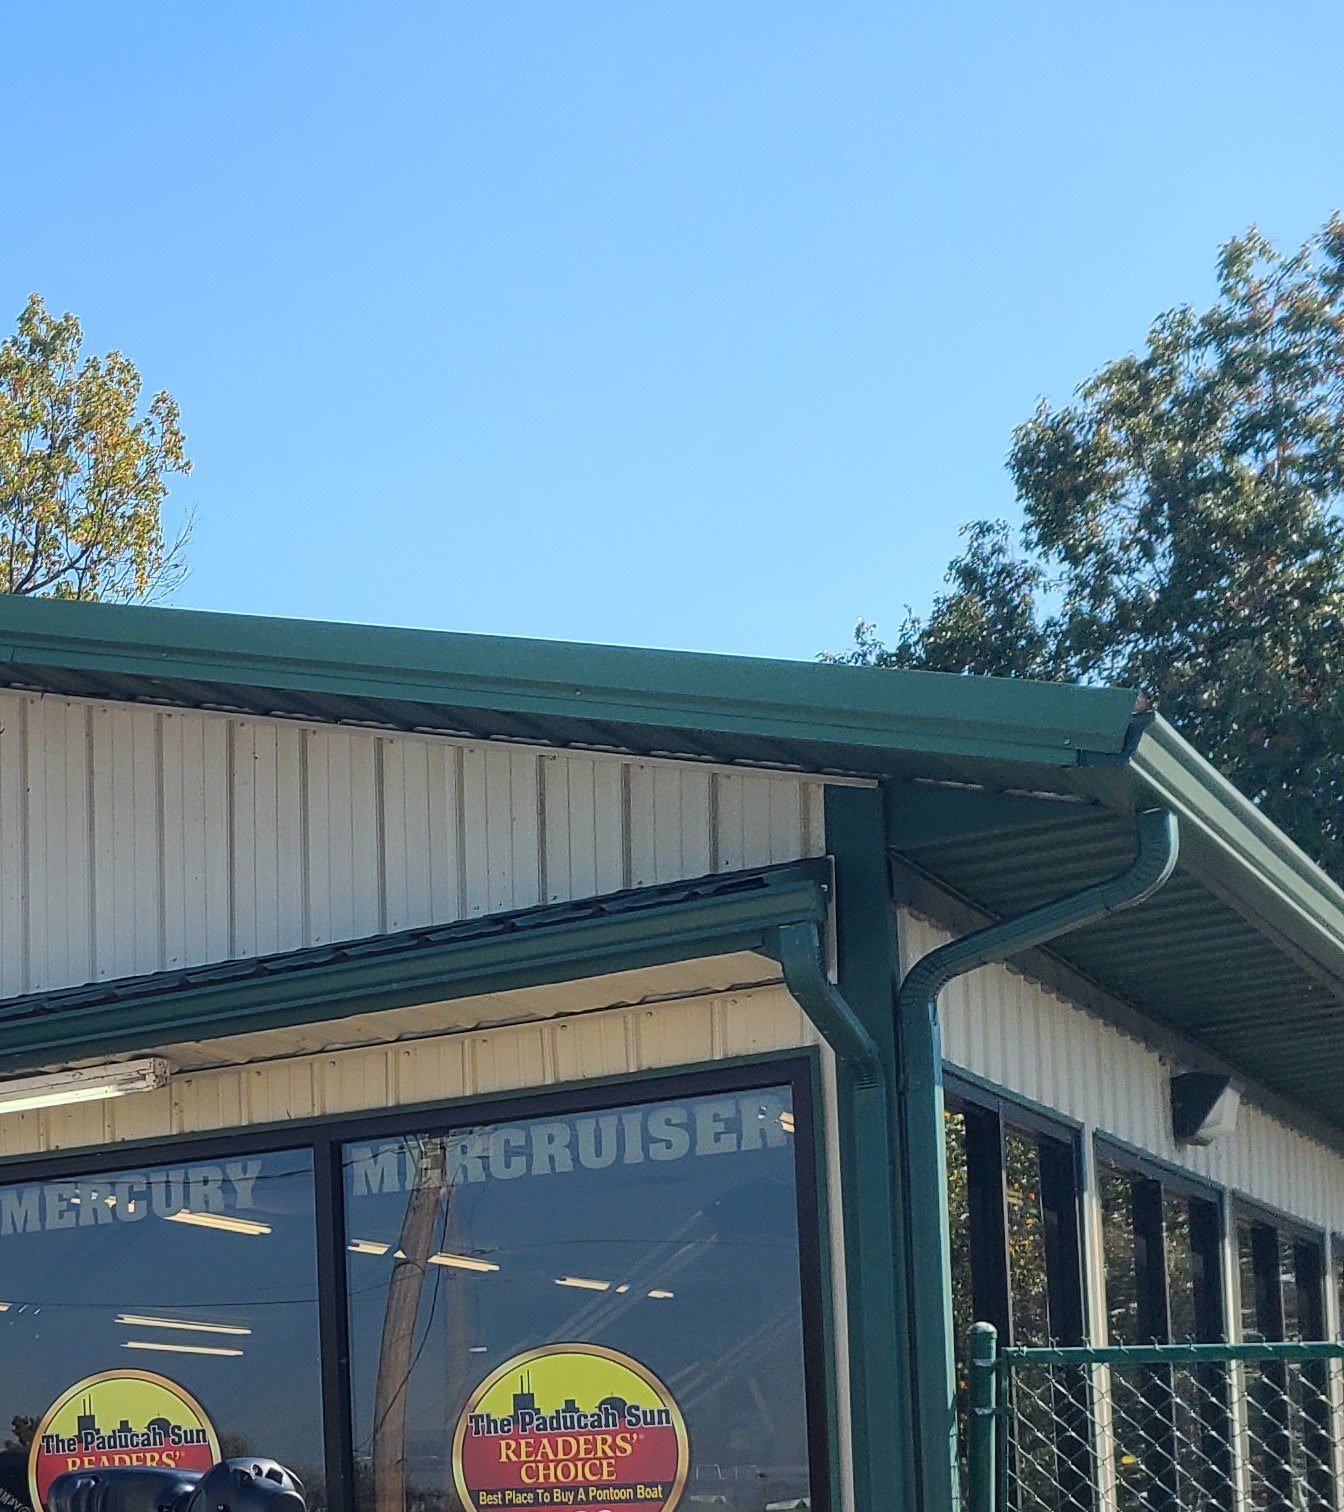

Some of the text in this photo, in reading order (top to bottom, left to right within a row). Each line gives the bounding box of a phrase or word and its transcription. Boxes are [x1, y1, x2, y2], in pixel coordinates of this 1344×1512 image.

[352, 1097, 793, 1196] MERCRUISER
[0, 1160, 262, 1236] MERCURY
[469, 1405, 672, 1436] The Paducah Sun
[41, 1424, 208, 1455] The Paducah Sun
[499, 1433, 638, 1462] READERS'
[520, 1459, 616, 1483] CHOICE
[479, 1484, 663, 1505] Best Place To Buy A Pontoon Boat
